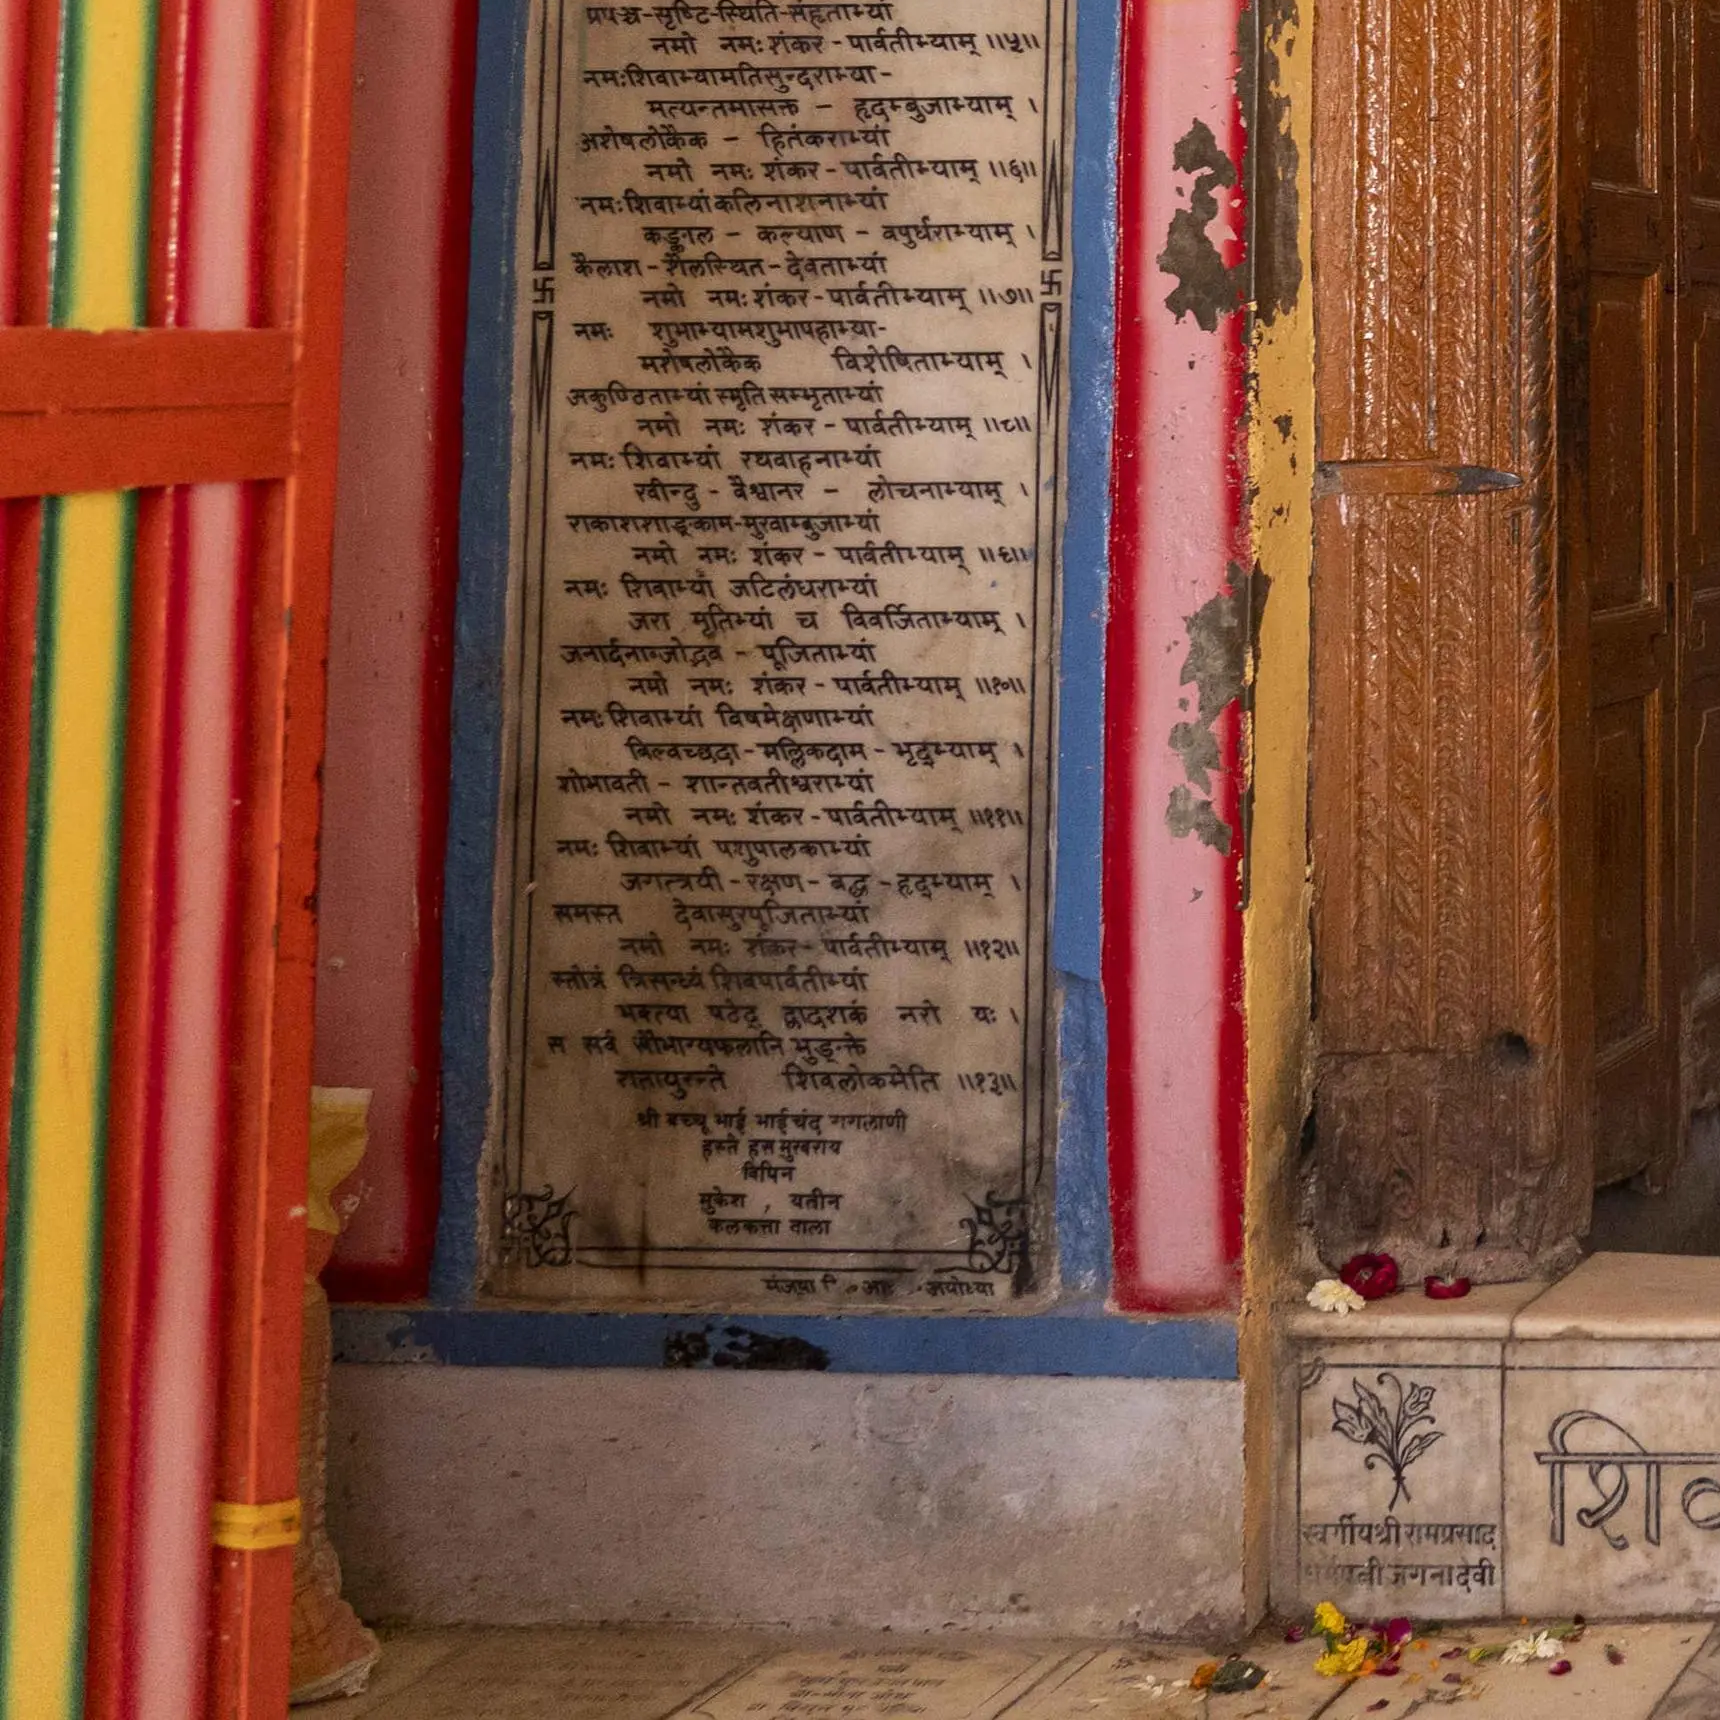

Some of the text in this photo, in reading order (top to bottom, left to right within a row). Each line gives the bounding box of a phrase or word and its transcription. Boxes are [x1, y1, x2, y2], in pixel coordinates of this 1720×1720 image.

[649, 33, 697, 54] नमो
[640, 283, 685, 307] नमो
[572, 322, 613, 341] नमः
[569, 452, 608, 469] नमः
[627, 671, 732, 695] नमो नमः
